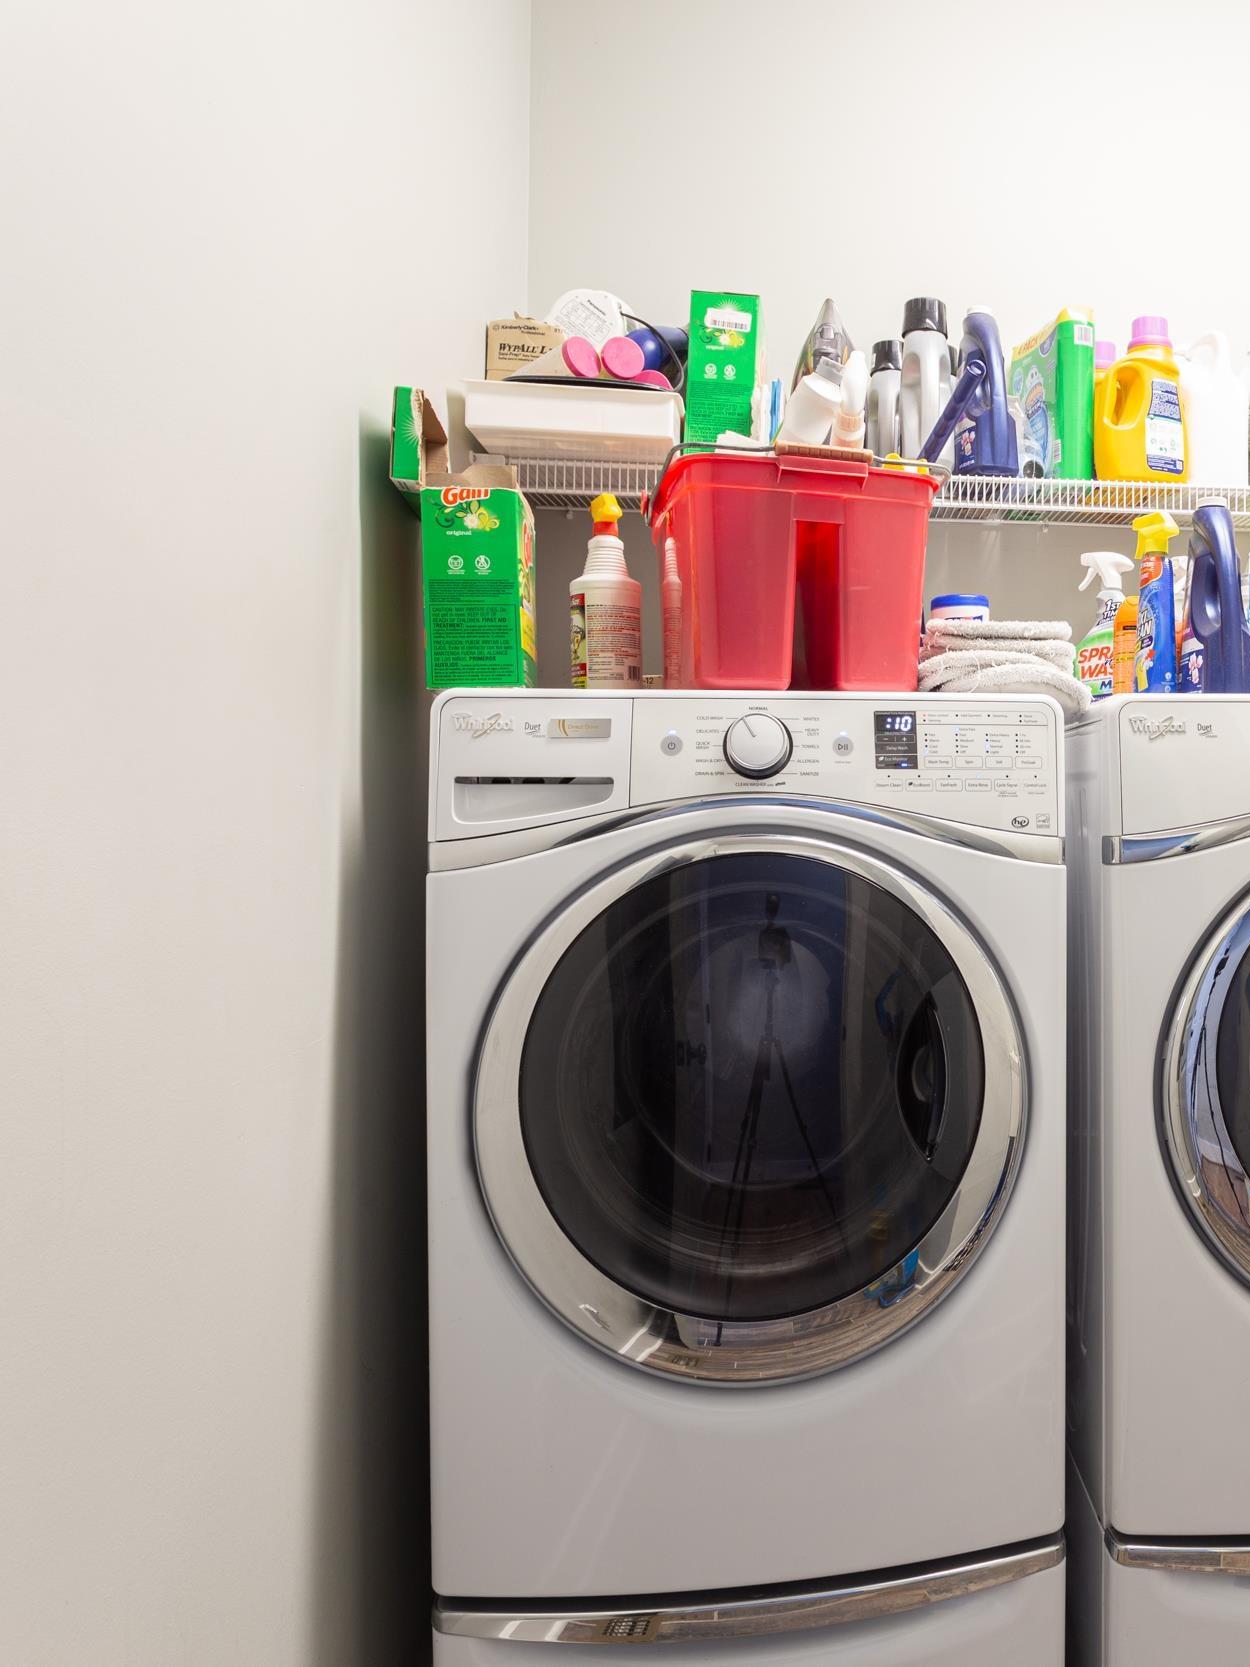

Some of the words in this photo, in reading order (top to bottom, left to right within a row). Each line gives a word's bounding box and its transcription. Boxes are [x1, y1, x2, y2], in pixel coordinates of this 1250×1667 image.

[441, 486, 490, 507] Gain
[1102, 611, 1118, 619] TIM
[452, 713, 514, 737] Whirlpool
[524, 721, 542, 731] Duet
[1128, 716, 1186, 739] Whirlpool
[1197, 723, 1212, 731] Duet
